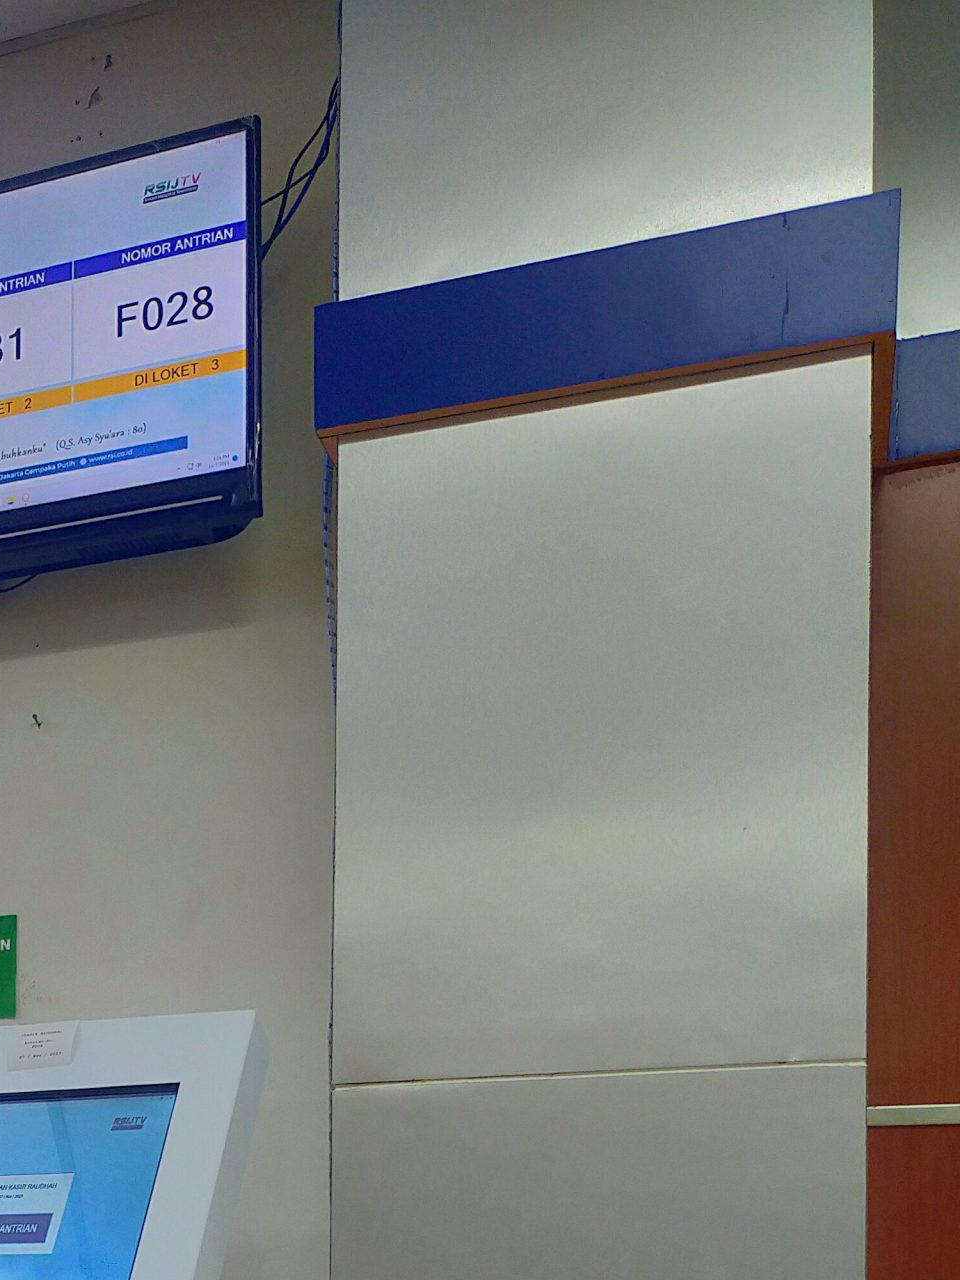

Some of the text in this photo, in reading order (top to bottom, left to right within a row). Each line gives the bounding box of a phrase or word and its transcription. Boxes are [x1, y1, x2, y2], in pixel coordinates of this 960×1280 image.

[121, 227, 234, 264] NOMOR ANTRIAN
[115, 285, 214, 338] F028
[134, 359, 220, 387] DI LOKET 3
[24, 398, 32, 410] 2
[78, 436, 93, 447] Asy
[132, 422, 147, 435] 80)
[0, 470, 24, 482] Jakarta
[25, 463, 56, 477] Cempaka
[57, 460, 76, 470] Putih
[0, 1223, 38, 1234] ANTRIAN
